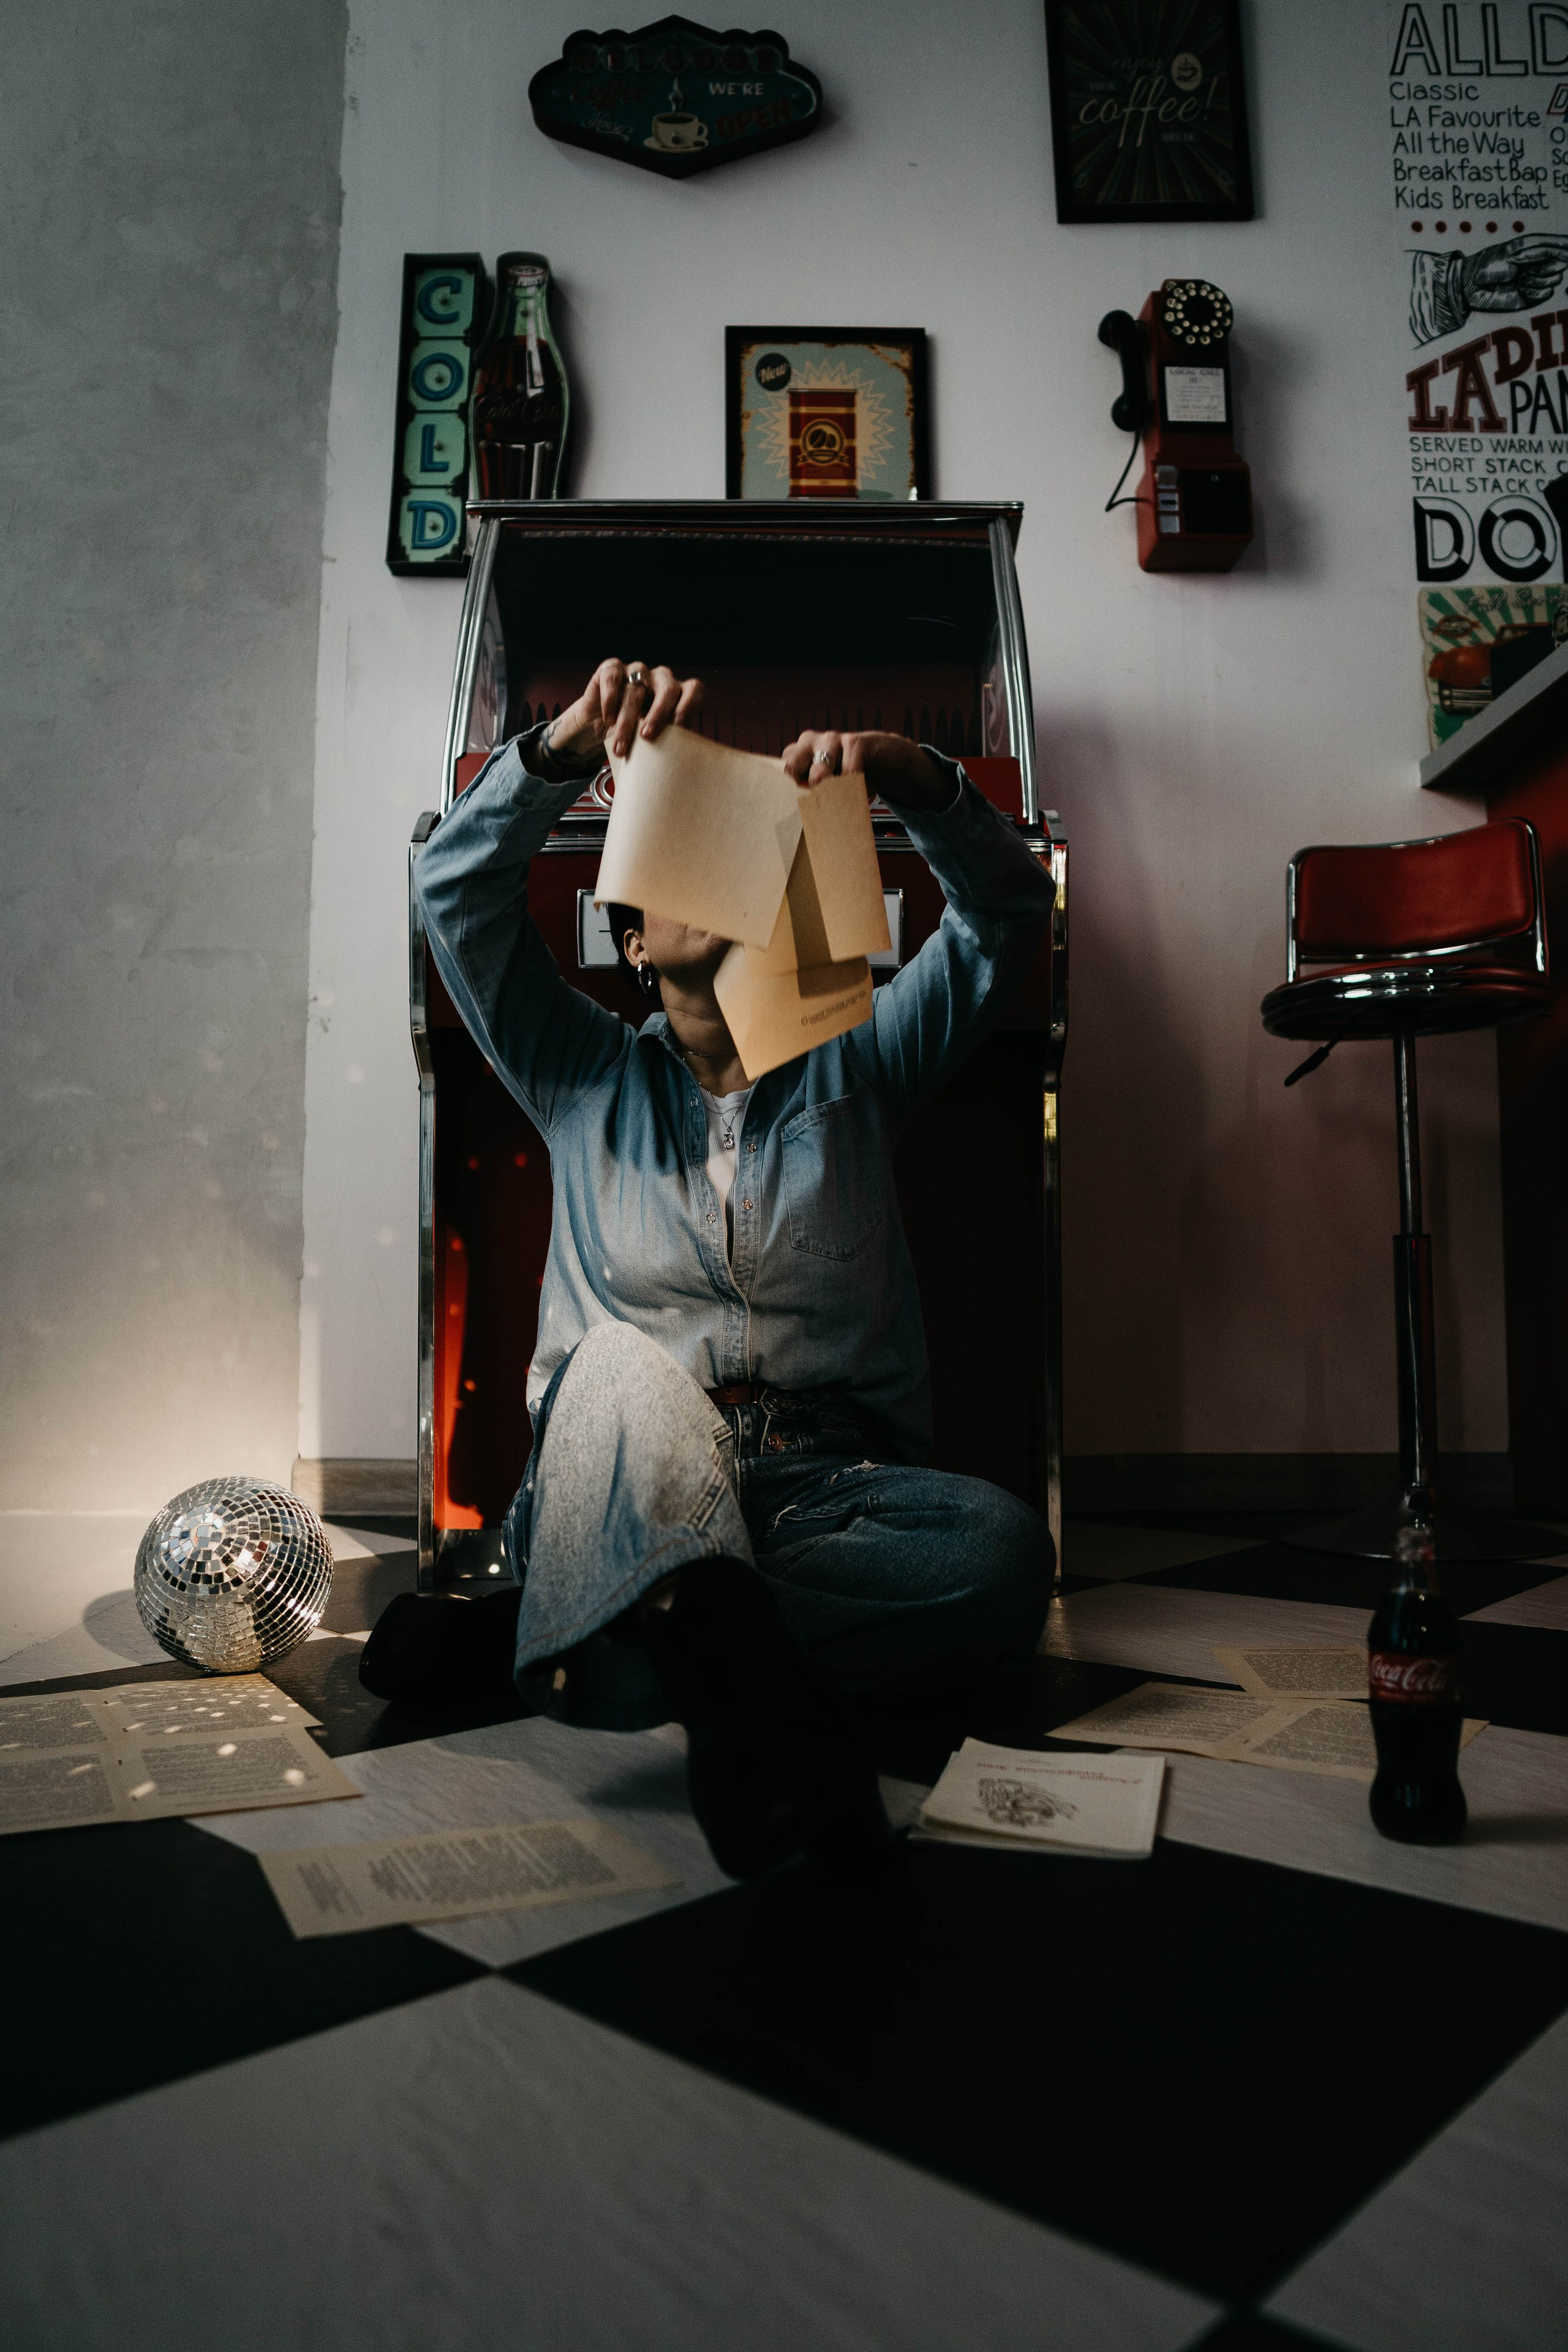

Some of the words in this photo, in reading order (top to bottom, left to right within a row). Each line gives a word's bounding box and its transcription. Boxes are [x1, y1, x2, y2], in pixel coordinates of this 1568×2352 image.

[708, 81, 764, 96] WE'RE
[1389, 81, 1480, 100] Classic
[1390, 105, 1421, 127] LA
[1428, 104, 1541, 128] Favourite
[1393, 131, 1422, 153] All
[1427, 131, 1469, 153] the
[1472, 131, 1525, 159] Way
[1395, 186, 1443, 209] Kids
[1452, 185, 1550, 209] Breakfast
[1409, 436, 1483, 453] SERVED
[1490, 437, 1544, 454] WARM
[1411, 456, 1476, 473] SHORT
[1486, 458, 1547, 474] STACK
[1412, 475, 1460, 492] TALL
[1466, 477, 1530, 493] STACK
